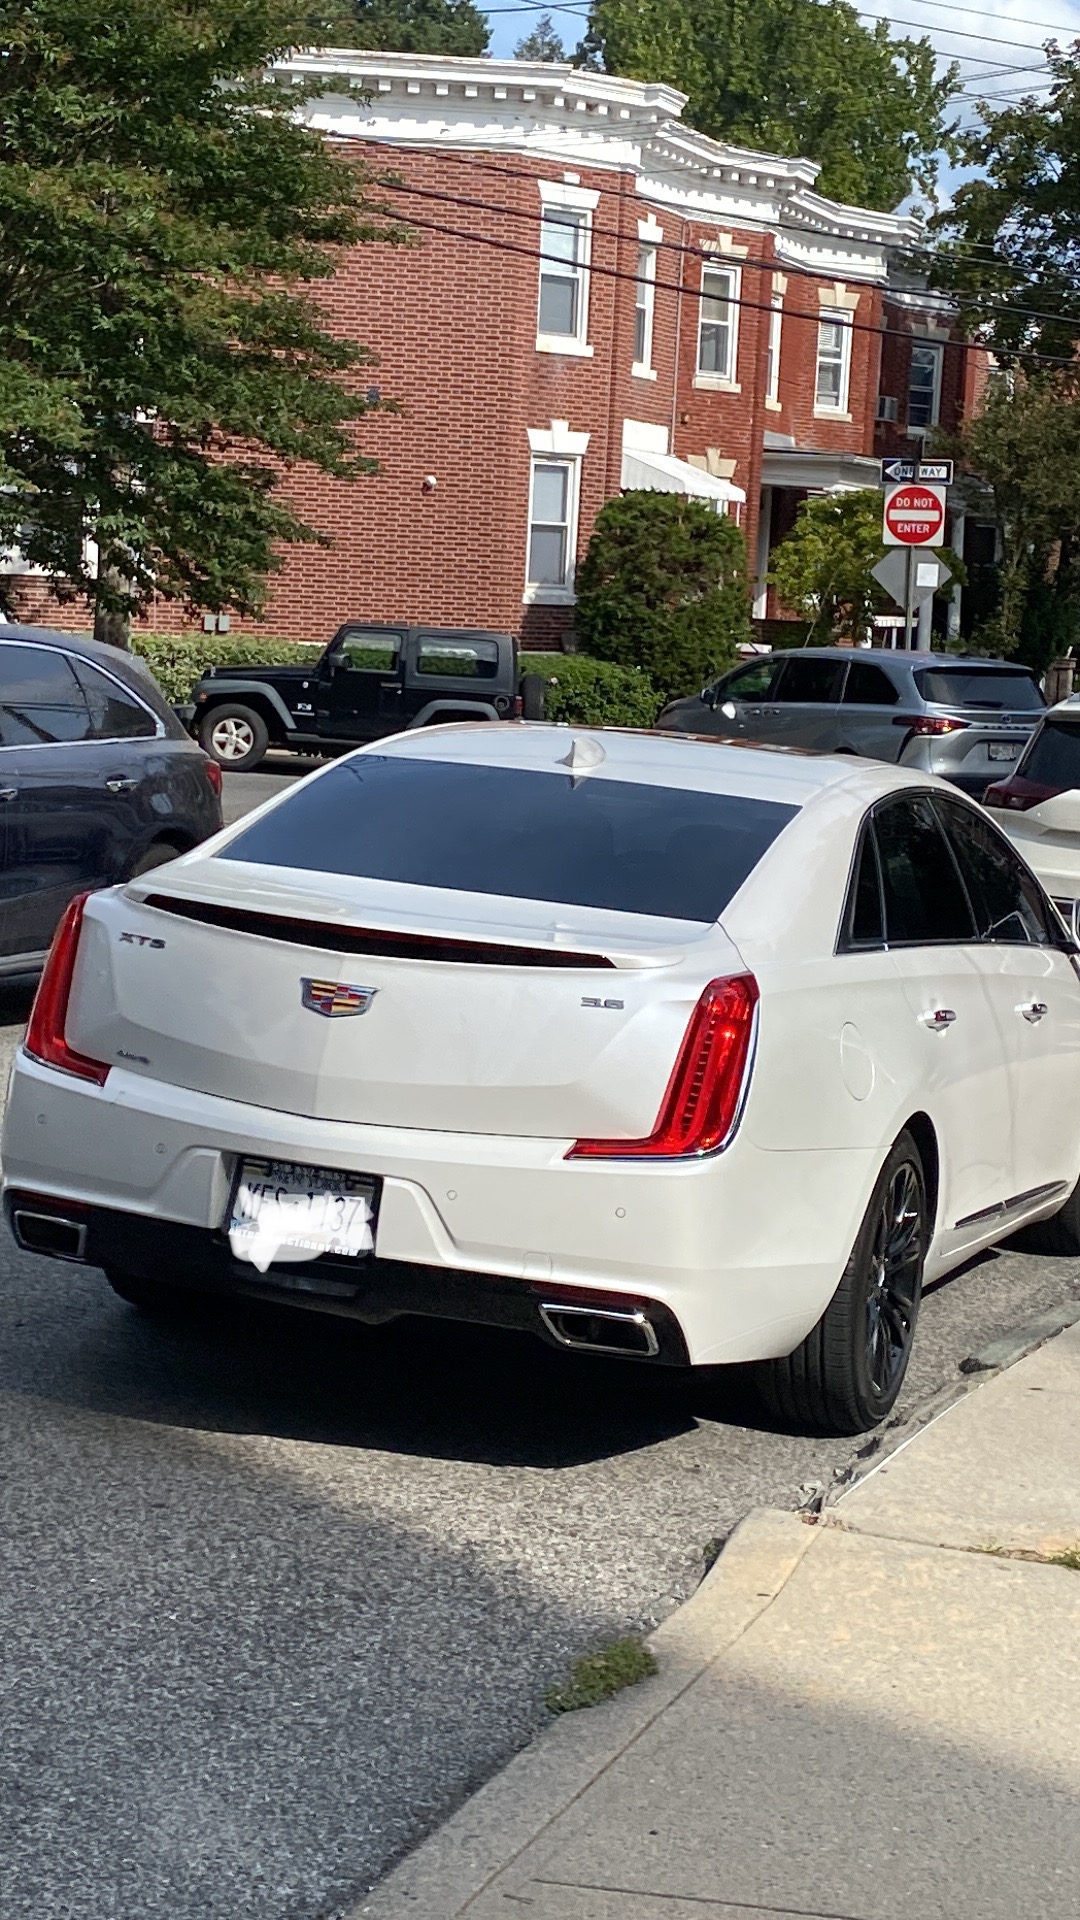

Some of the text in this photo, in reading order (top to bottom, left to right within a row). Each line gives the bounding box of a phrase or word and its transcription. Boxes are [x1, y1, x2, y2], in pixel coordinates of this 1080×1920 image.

[921, 466, 942, 477] WAY
[896, 498, 934, 509] DO NOT
[897, 523, 930, 534] ENTER
[119, 932, 167, 949] XTS
